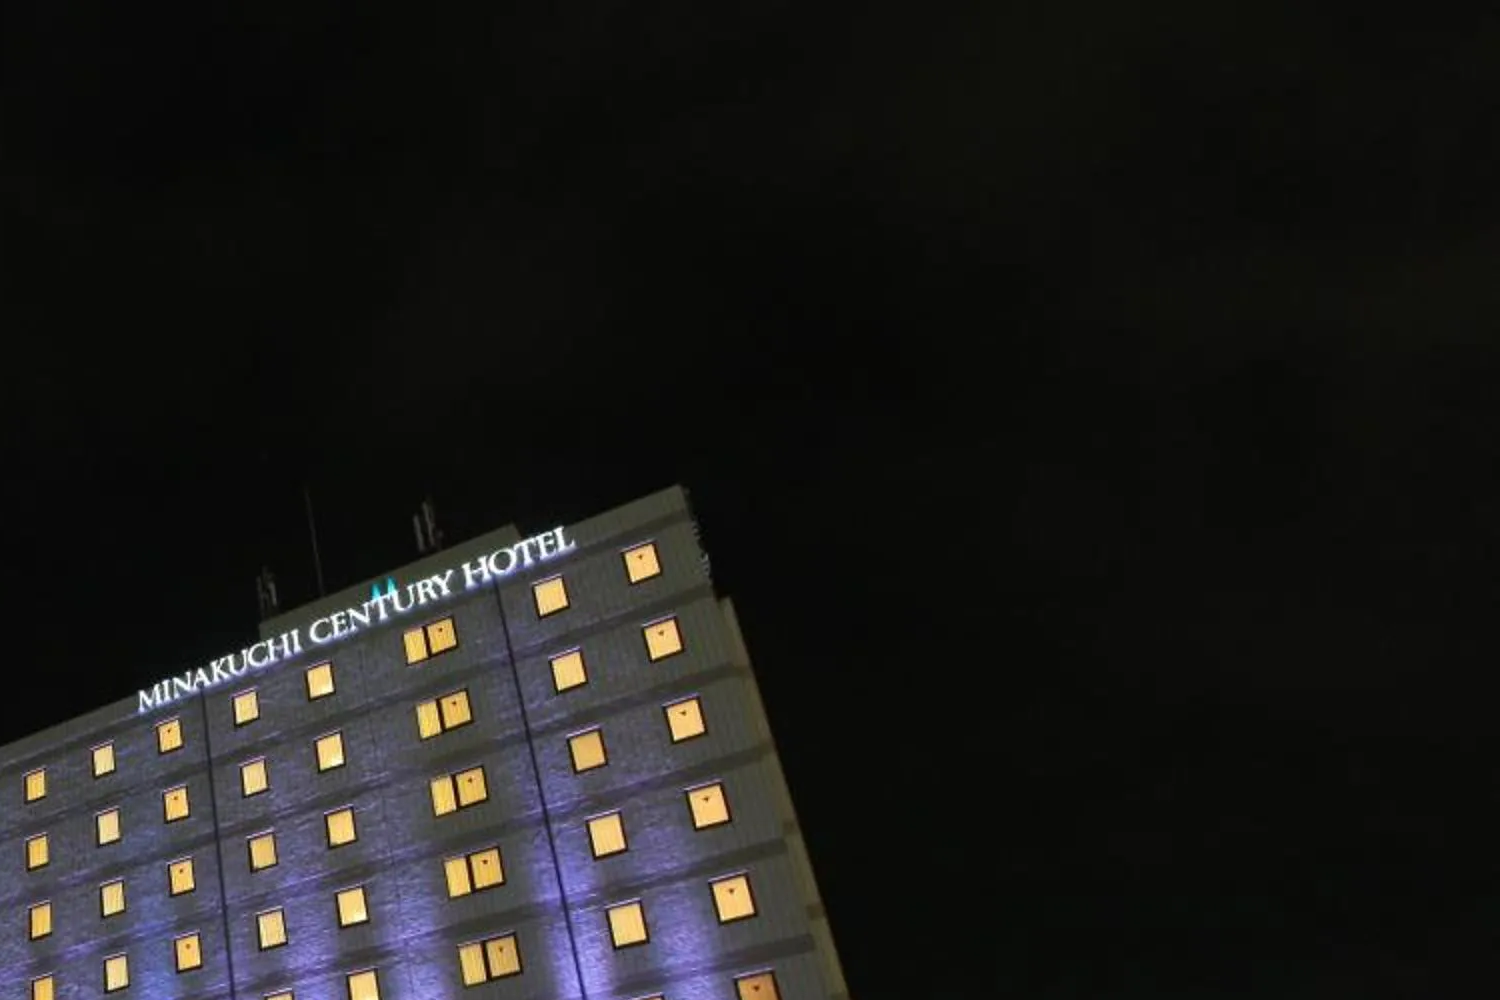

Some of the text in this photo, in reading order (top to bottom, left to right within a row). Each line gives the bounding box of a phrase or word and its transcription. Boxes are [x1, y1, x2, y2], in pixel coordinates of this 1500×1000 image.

[137, 525, 577, 713] MINAKUCHI CENTURY HOTEL
